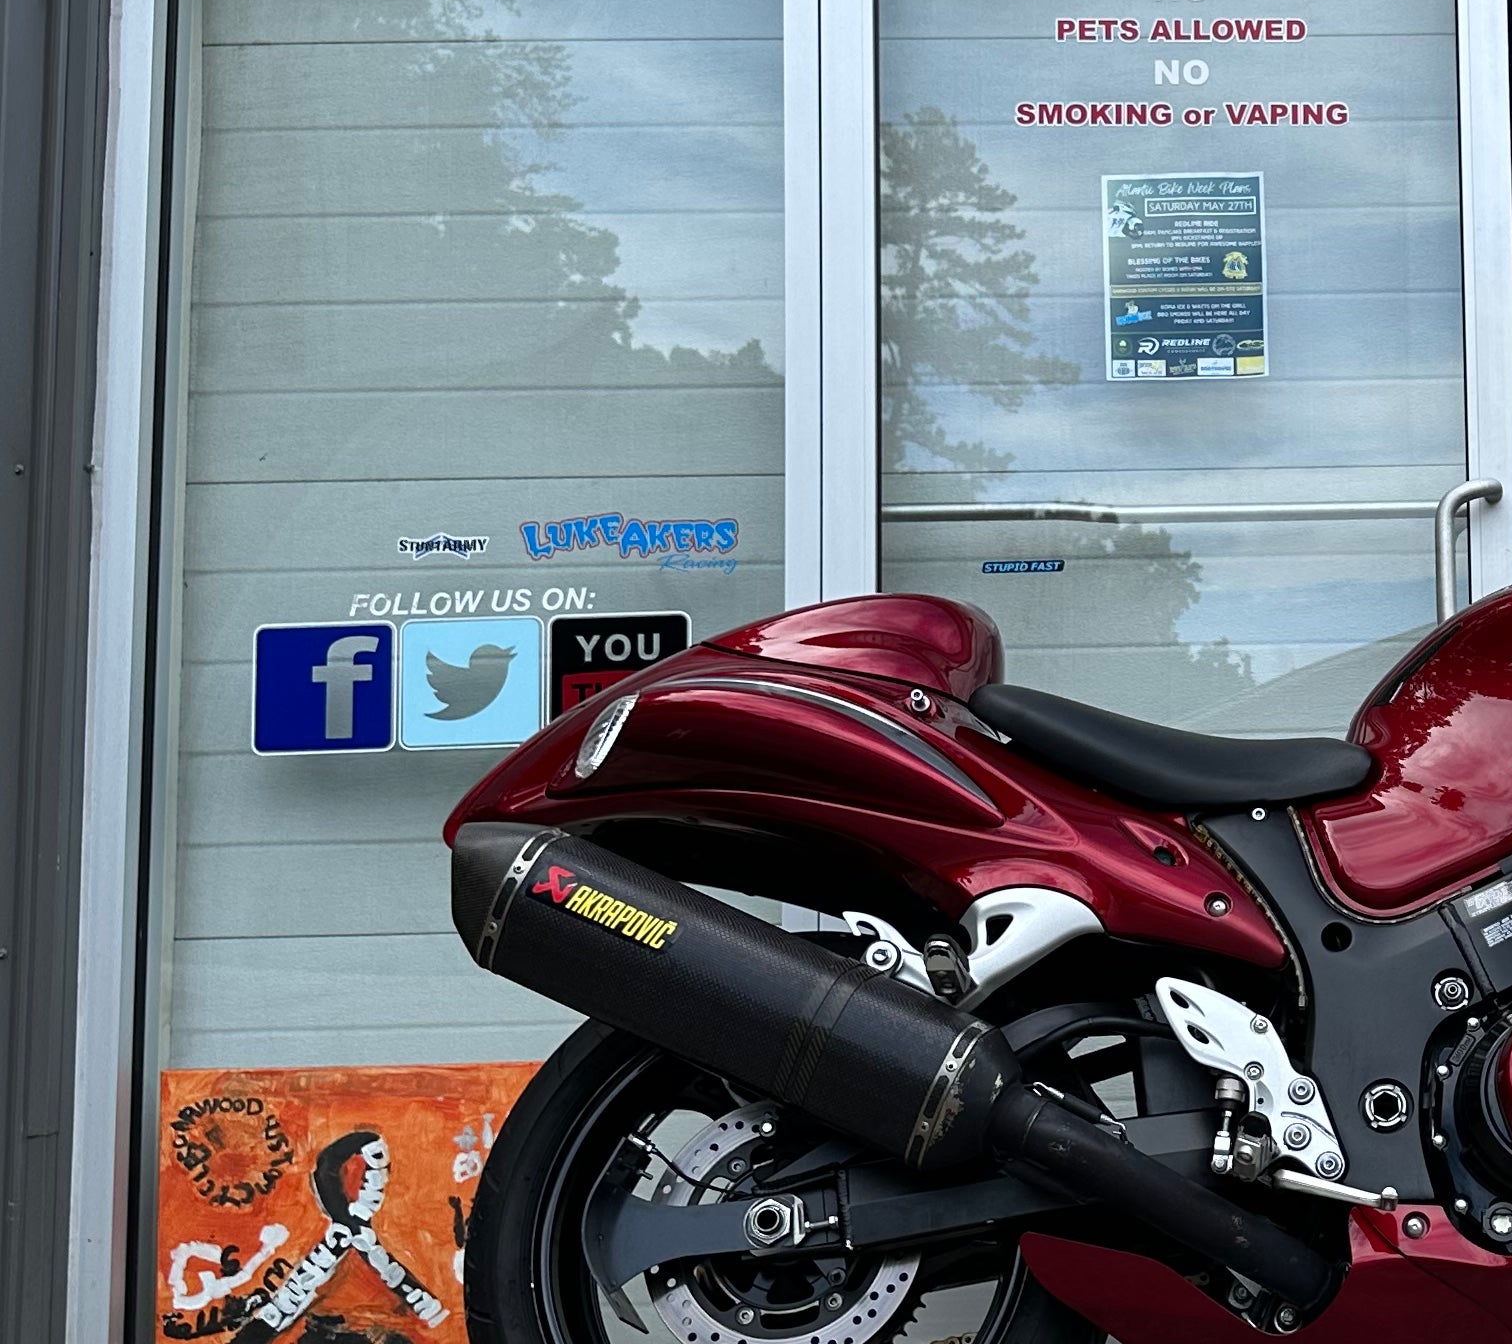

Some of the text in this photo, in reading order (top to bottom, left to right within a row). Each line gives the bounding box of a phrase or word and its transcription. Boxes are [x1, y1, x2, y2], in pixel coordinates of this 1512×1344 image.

[1056, 19, 1306, 41] PETS ALLOWED
[1154, 59, 1209, 84] NO
[1016, 103, 1348, 125] SMOKING or VAPING
[1158, 182, 1182, 195] Bike
[1187, 181, 1215, 194] Week
[1149, 200, 1253, 212] SATURDAY MAY 27TH
[1161, 338, 1212, 347] REDLINE
[521, 513, 738, 558] LUKE AKERS
[658, 553, 739, 575] Racing
[984, 561, 1062, 573] STUPID FAST
[349, 587, 596, 617] FOLLOW US ON:
[575, 632, 662, 662] YOU
